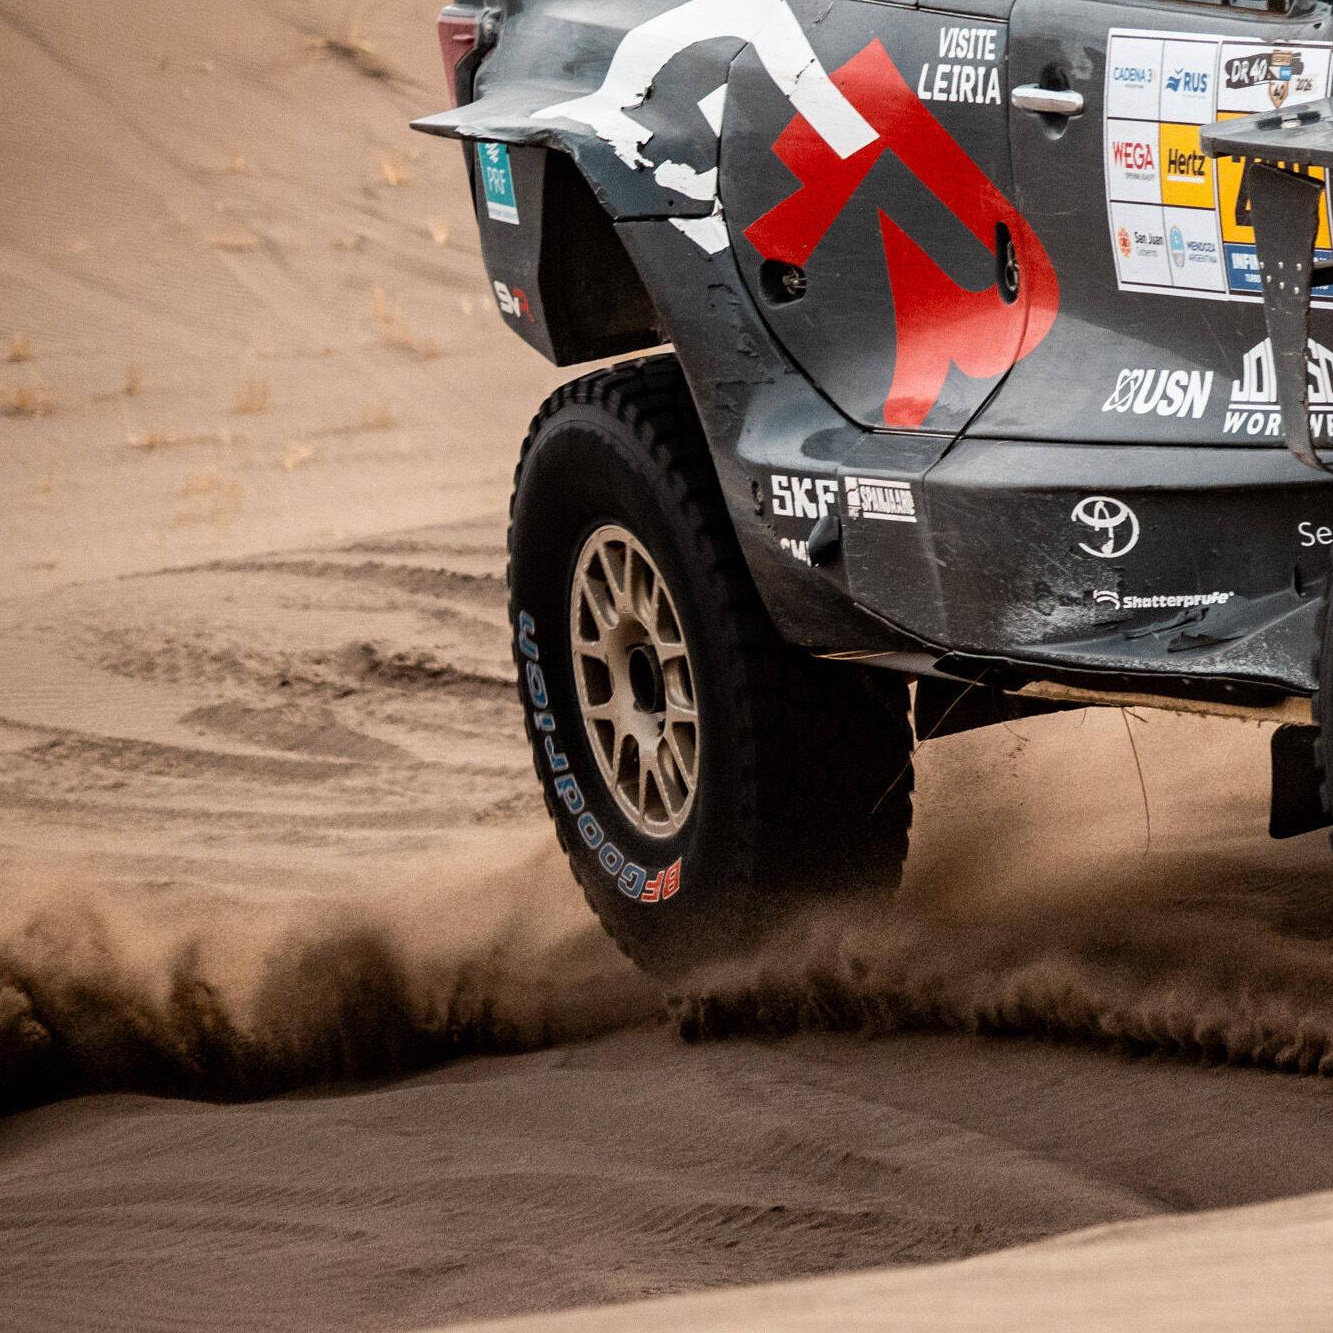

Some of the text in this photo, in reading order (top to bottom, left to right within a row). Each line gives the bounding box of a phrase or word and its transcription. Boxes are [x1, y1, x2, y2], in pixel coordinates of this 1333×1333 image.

[938, 27, 997, 61] VISITE
[917, 63, 1002, 105] LEIRIA
[1113, 67, 1146, 82] CADENA
[1184, 71, 1208, 93] RUS
[1231, 60, 1250, 84] DR
[1249, 58, 1268, 83] 40
[1112, 141, 1155, 170] WEGA
[1168, 148, 1206, 177] Hertz
[1134, 231, 1163, 246] San Juan
[1132, 369, 1214, 419] USN
[771, 474, 839, 519] SKF
[1122, 591, 1230, 609] Shatterprufe
[519, 609, 683, 903] BFGoodrich
